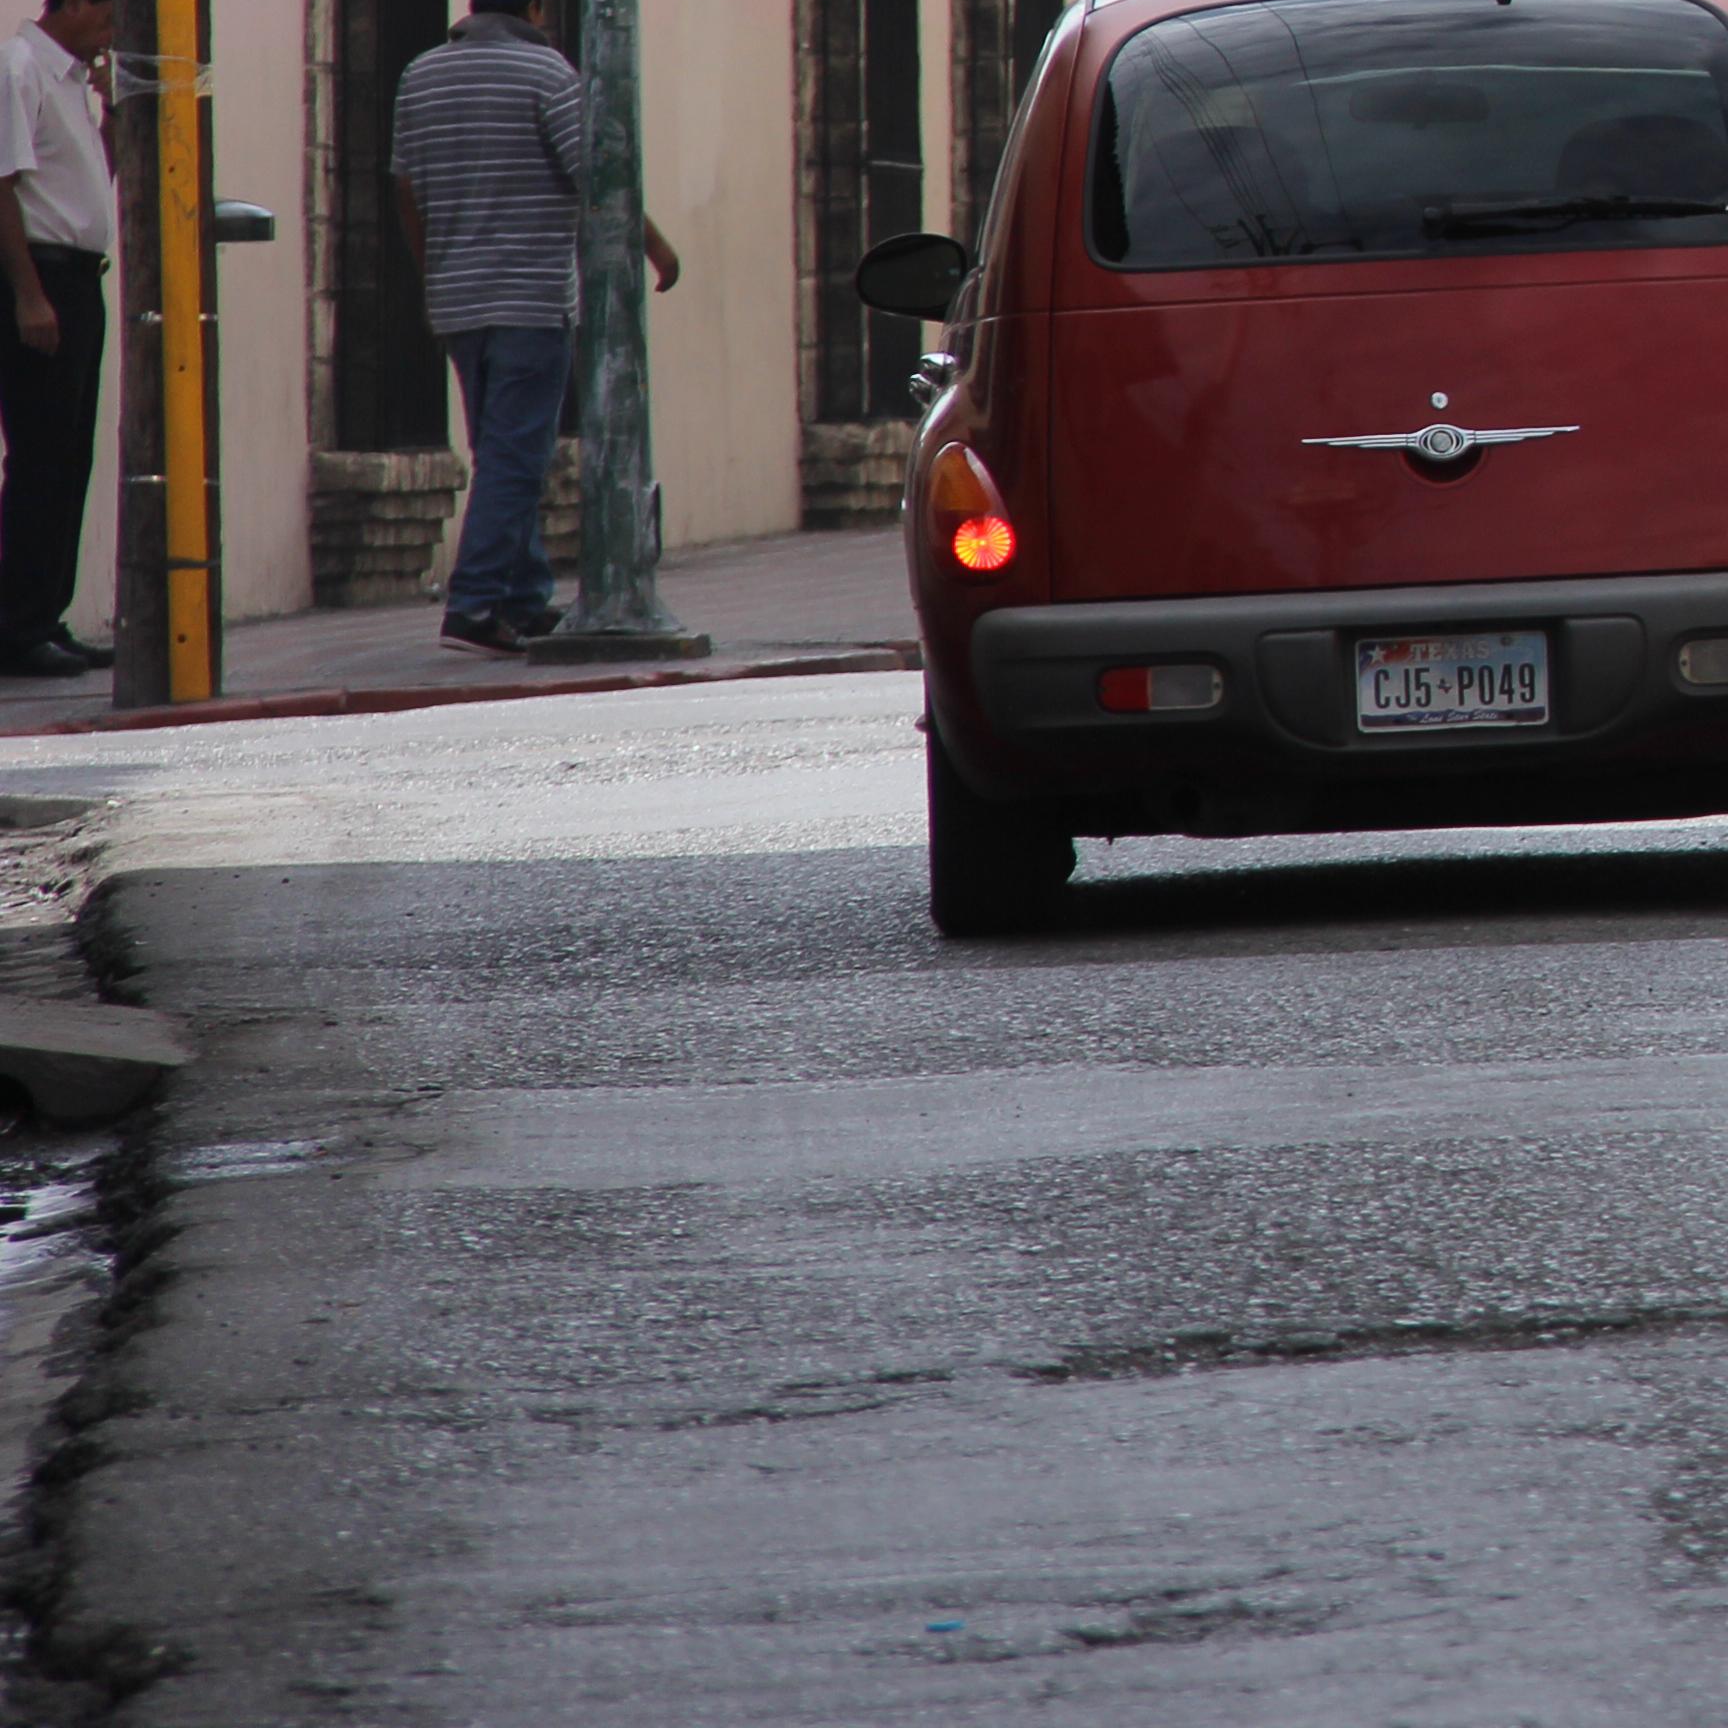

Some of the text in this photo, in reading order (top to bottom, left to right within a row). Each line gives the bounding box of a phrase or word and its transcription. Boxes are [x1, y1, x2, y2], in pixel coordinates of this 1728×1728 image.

[1410, 640, 1491, 662] TEXAS
[1373, 662, 1537, 709] CJ5 P049
